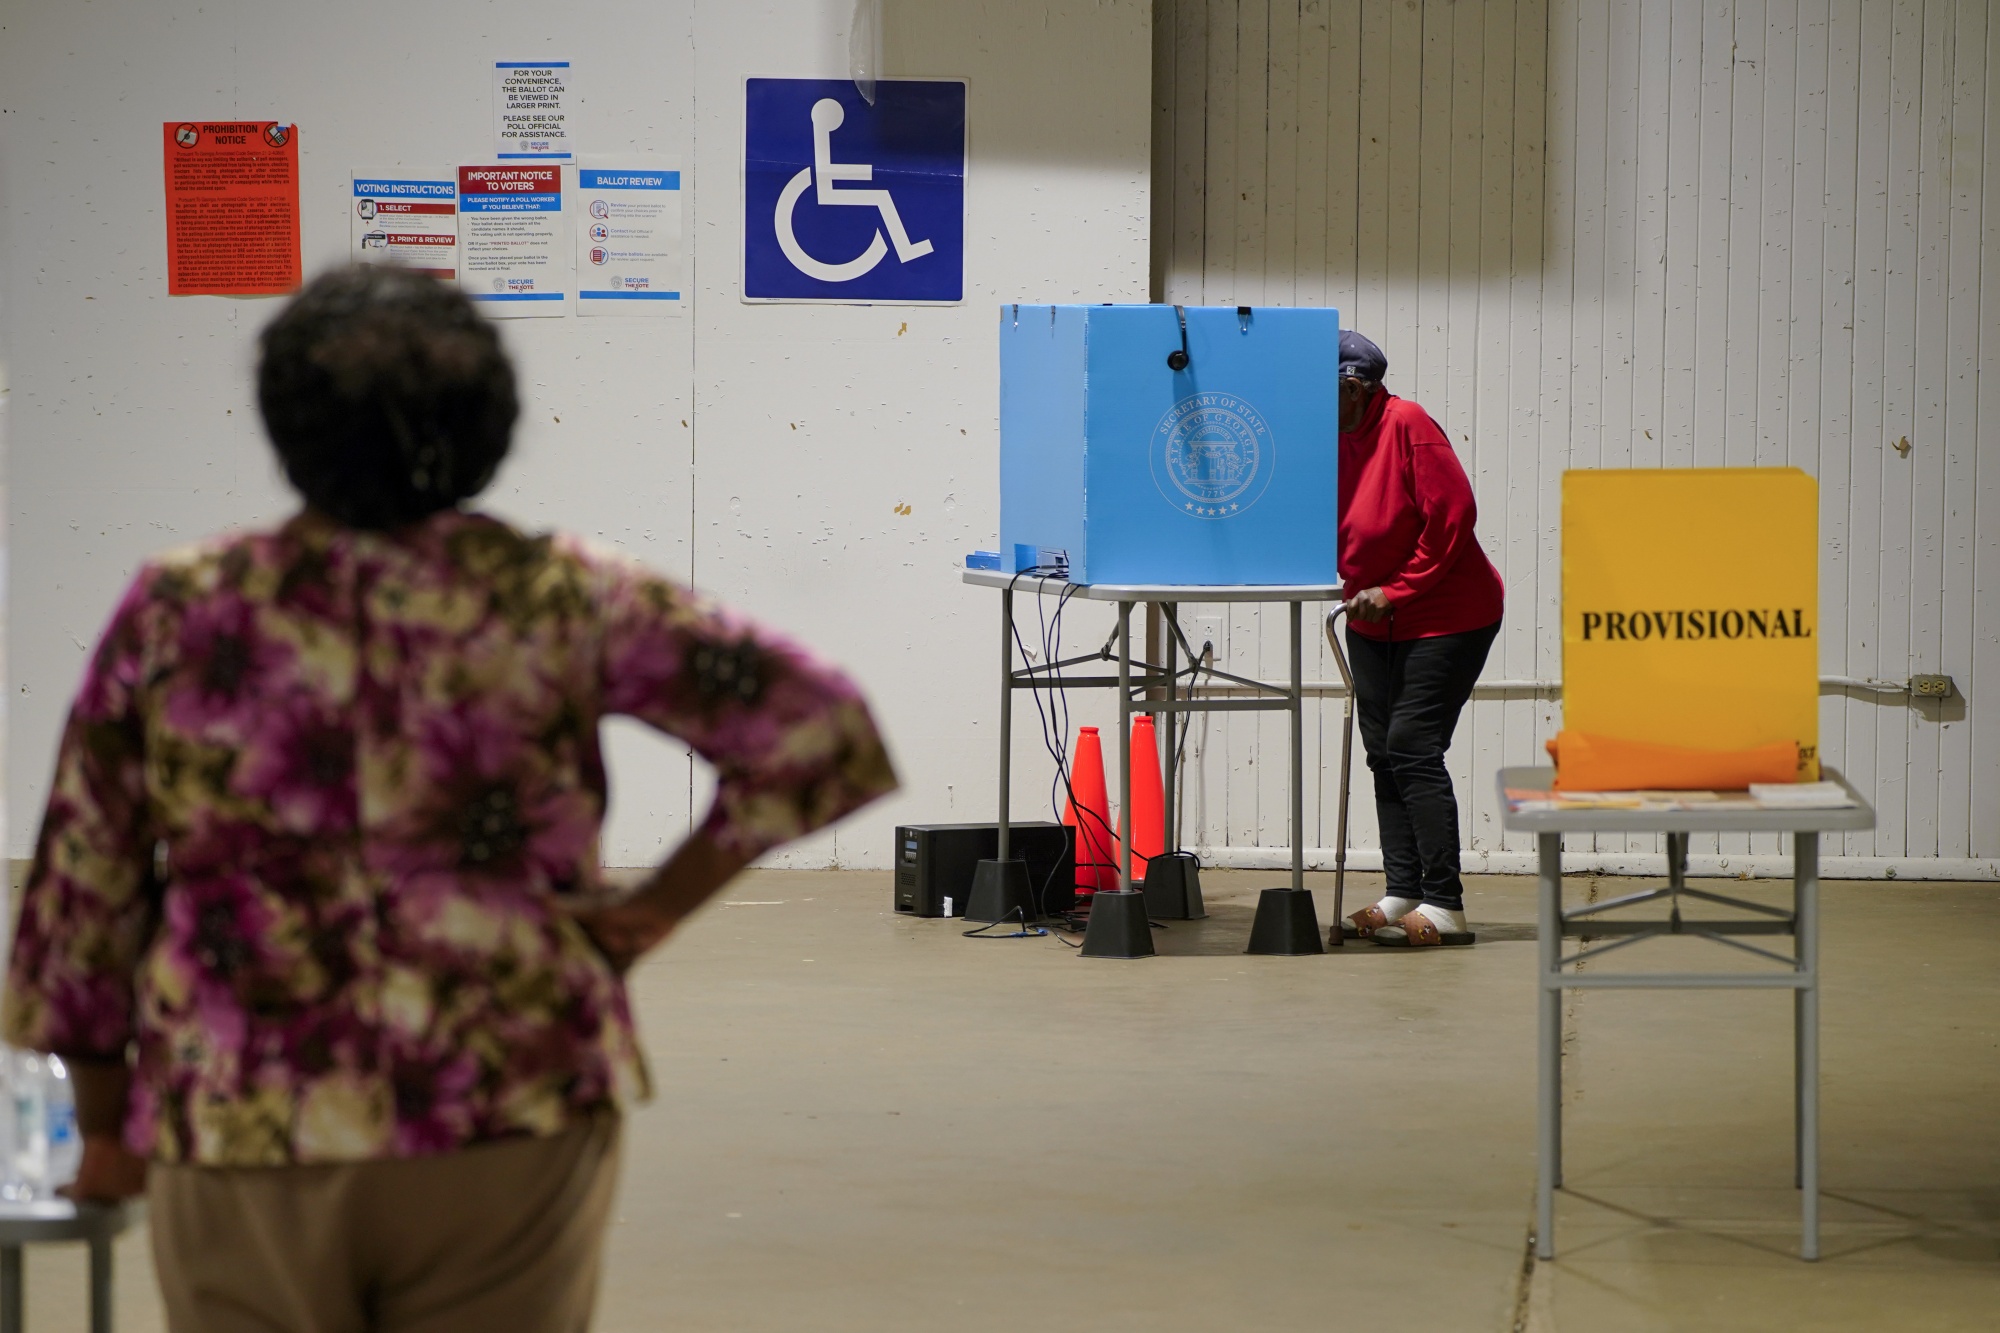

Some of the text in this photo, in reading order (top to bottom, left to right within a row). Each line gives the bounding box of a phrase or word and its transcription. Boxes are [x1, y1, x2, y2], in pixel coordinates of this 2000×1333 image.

[203, 125, 258, 133] PROHIBITION
[215, 136, 246, 144] NOTICE
[468, 172, 552, 180] IMPORTANT NOTICE
[487, 182, 534, 190] TO VOTERS
[597, 177, 662, 186] BALLOT REVIEW
[356, 184, 453, 194] VOTING INSTRUCTIONS
[1160, 396, 1266, 436] SECRETARY OF STATE
[1171, 423, 1192, 464] STATE
[1194, 415, 1209, 424] OF
[1214, 414, 1253, 464] GEORGIA
[1582, 607, 1811, 641] PROVISIONAL
